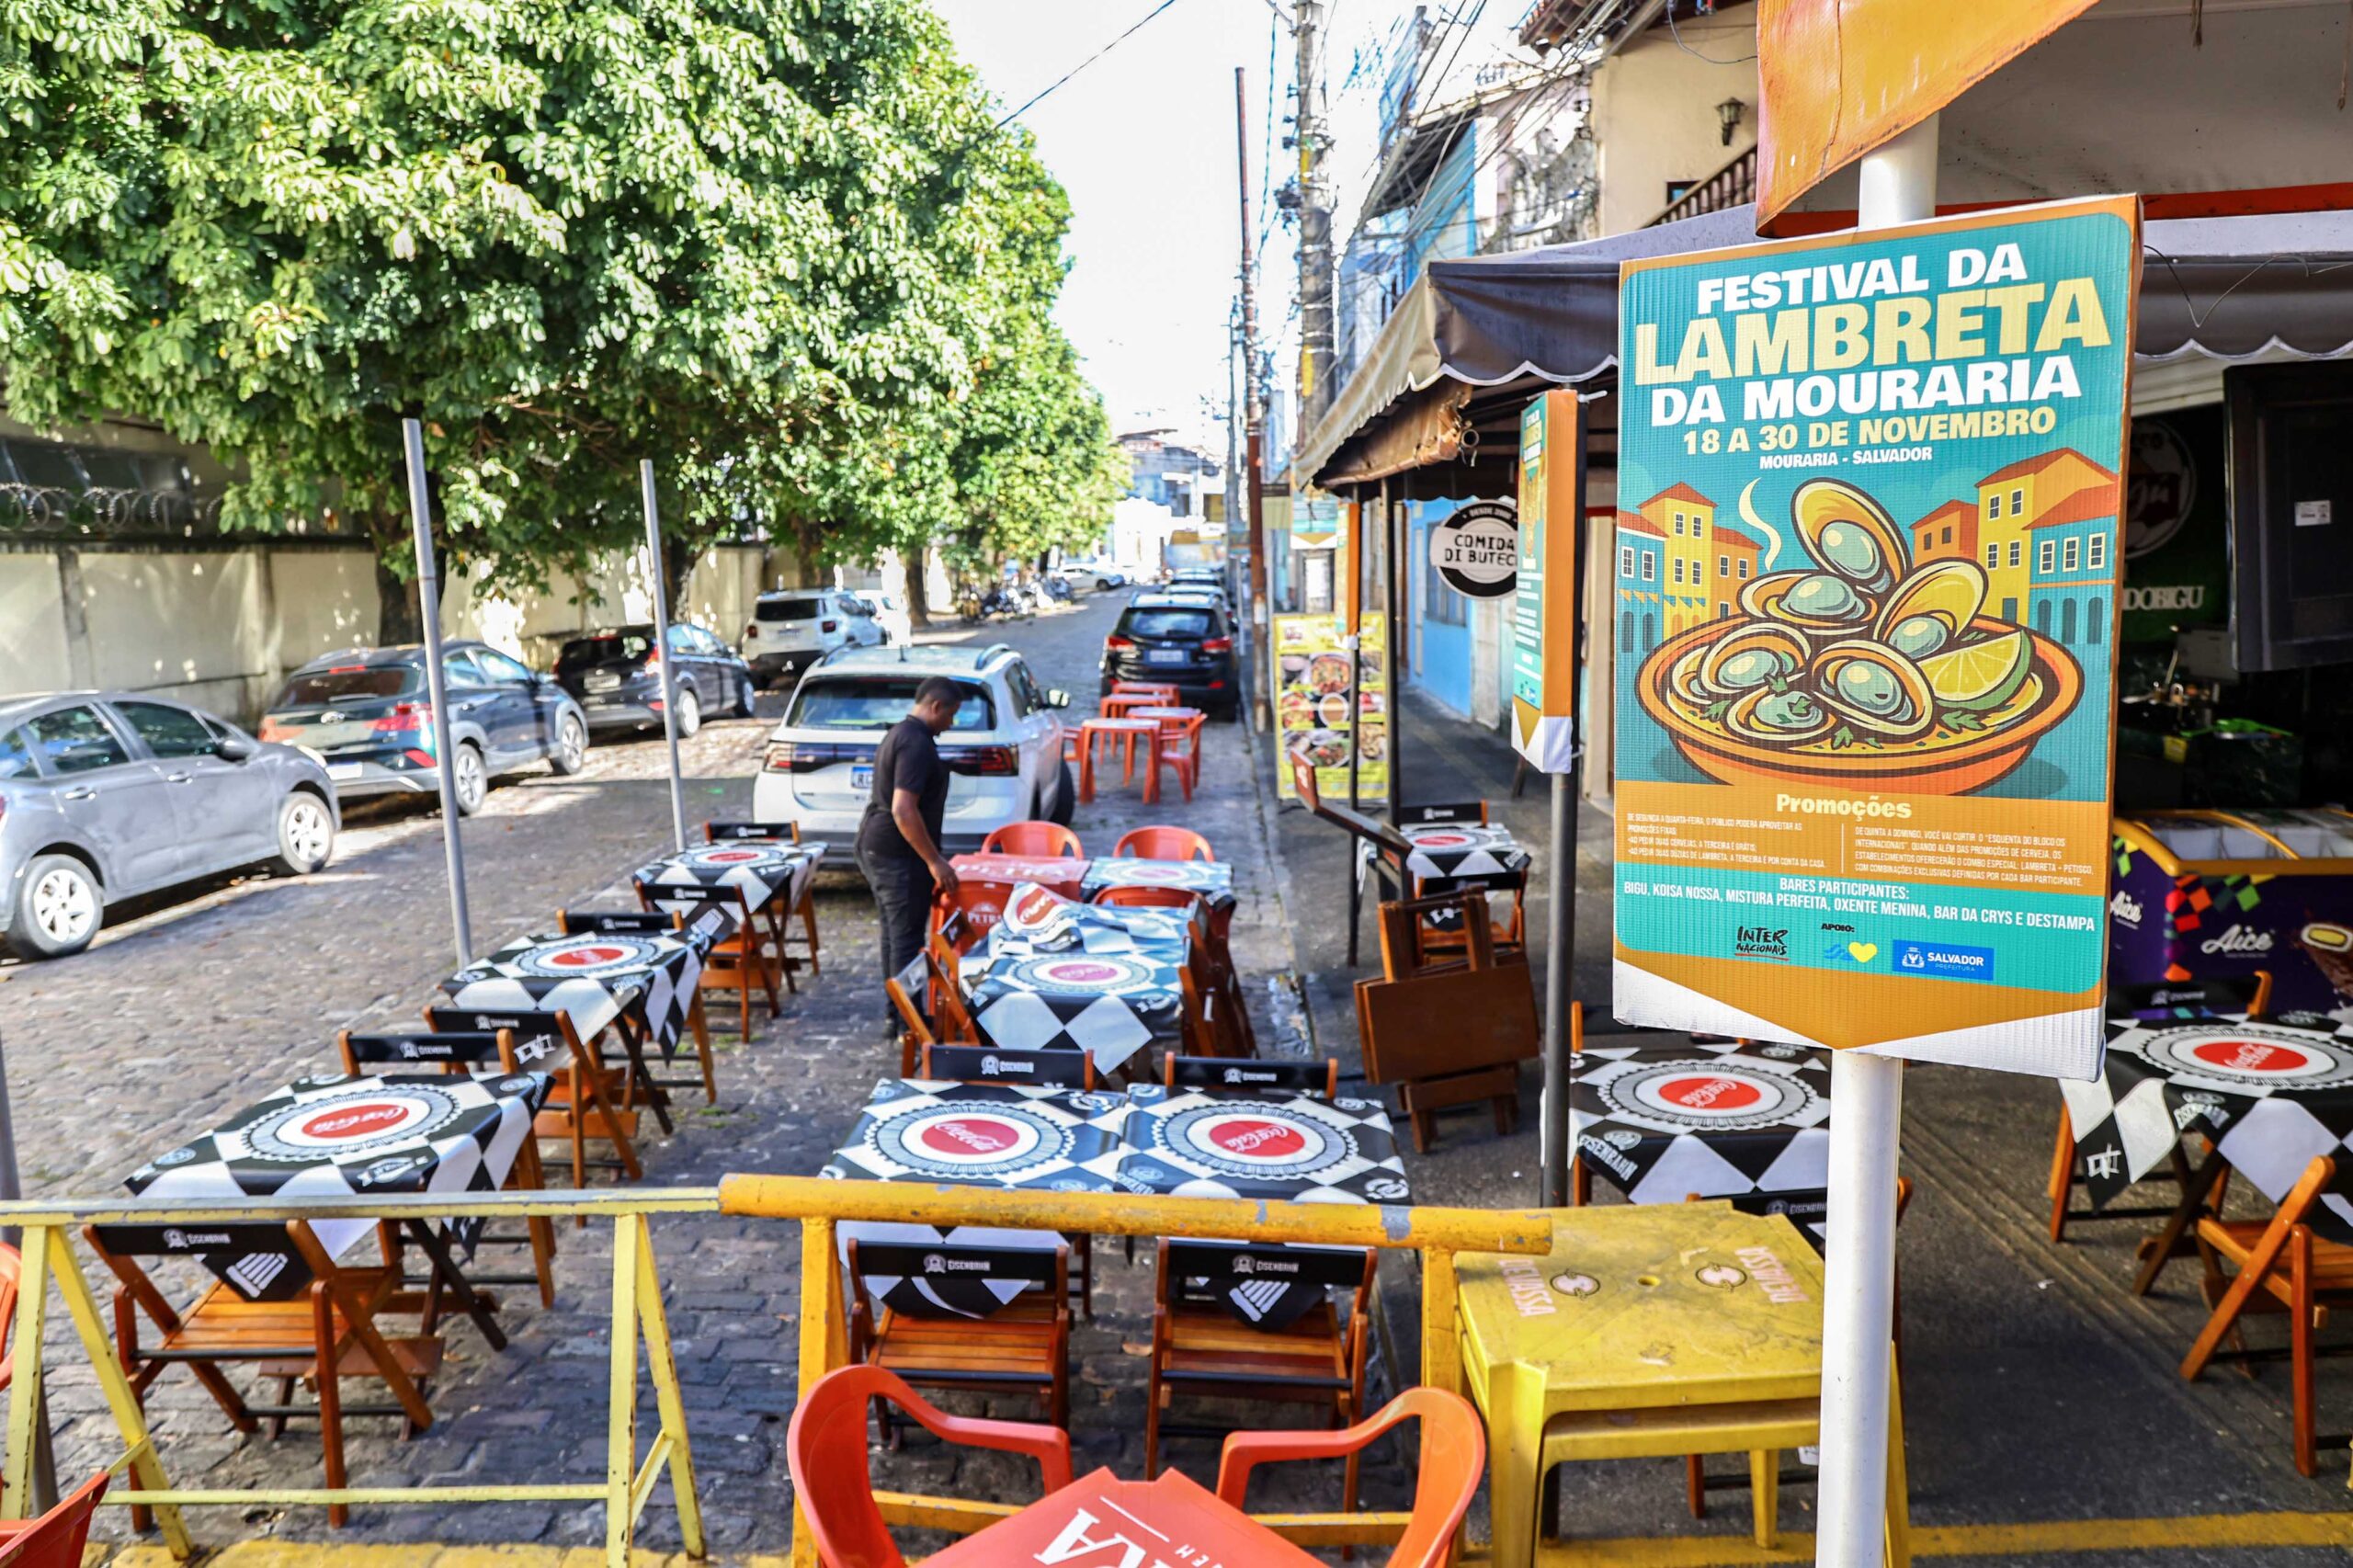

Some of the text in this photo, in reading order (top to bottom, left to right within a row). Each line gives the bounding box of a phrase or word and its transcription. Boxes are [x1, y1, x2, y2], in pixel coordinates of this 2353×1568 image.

[1698, 243, 2028, 314] FESTIVAL DA
[1635, 277, 2111, 386] LAMBRETA
[1652, 355, 2081, 426] DA MOURARIA
[1684, 405, 2056, 455] 18 A 30 DE NOVEMBRO
[1759, 451, 1837, 470] MOURARIA
[1852, 447, 1932, 466] SALVADOR
[1454, 534, 1515, 551] COMIDA
[1445, 549, 1461, 562] DI
[1469, 550, 1518, 567] BUTEC
[1776, 793, 1912, 822] Promoções
[1779, 877, 1910, 900] BARES PARTICIPANTES:
[1653, 882, 1683, 898] KOISA
[1685, 885, 1723, 903] NOSSA,
[1725, 889, 1774, 906] MISTURA
[1777, 893, 1831, 912] PERFEITA,
[1834, 897, 1879, 915] OXENTE
[1881, 901, 1931, 919] MENINA,
[1933, 905, 1959, 921] BAR
[1961, 908, 1978, 922] DA
[1981, 909, 2013, 926] CRYS
[2016, 912, 2023, 926] E
[2026, 913, 2096, 932] DESTAMPA
[1737, 926, 1789, 945] INTER
[1821, 923, 1855, 934] APOIO:
[2200, 923, 2274, 954] Aice
[1927, 951, 1984, 967] SALVADOR
